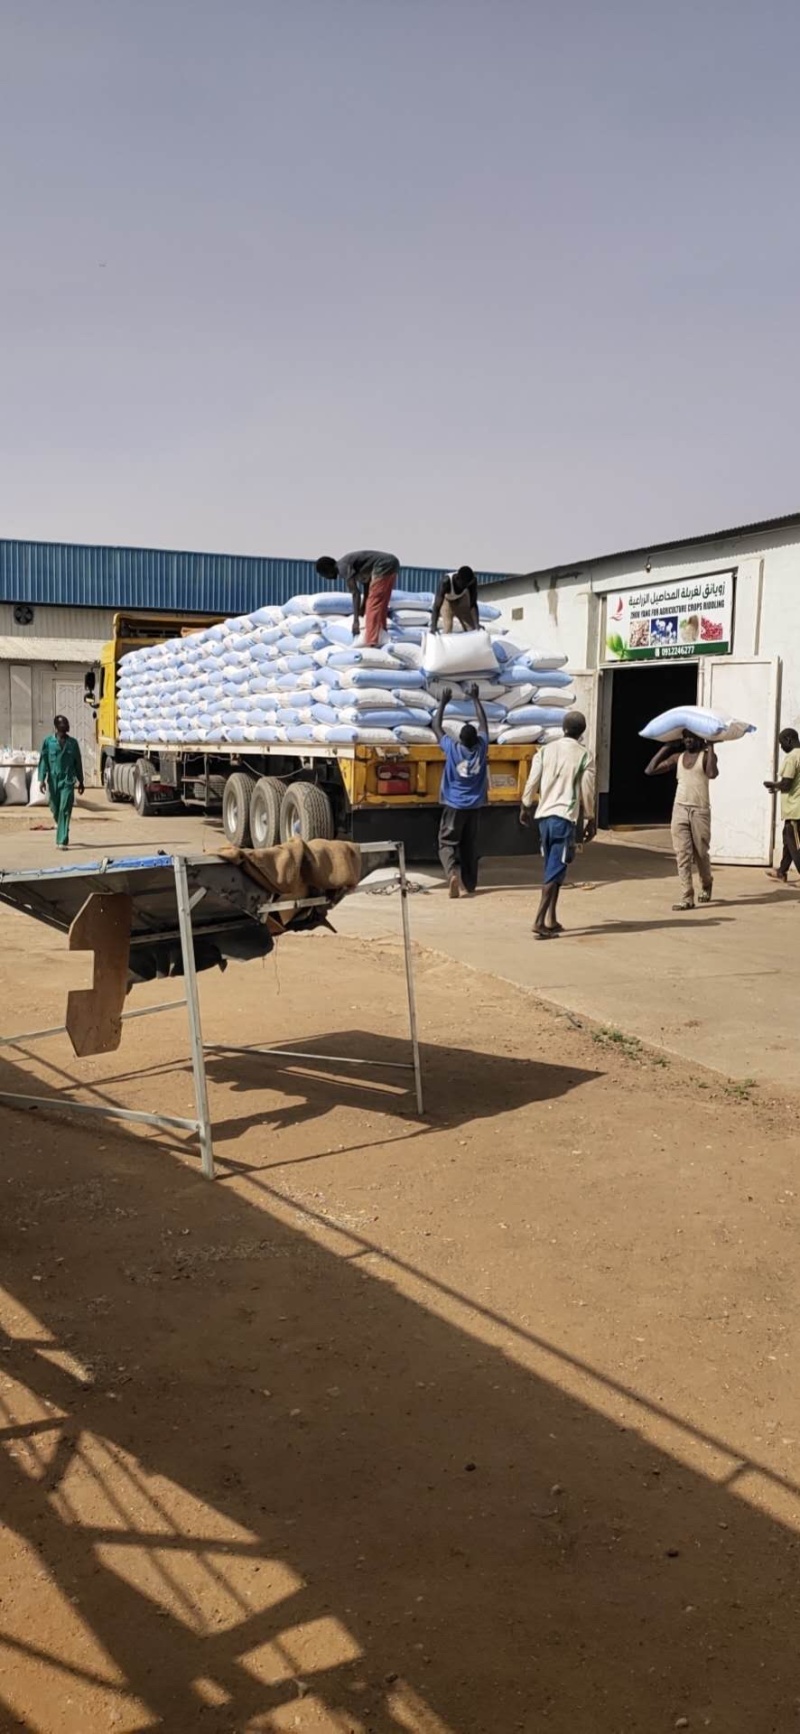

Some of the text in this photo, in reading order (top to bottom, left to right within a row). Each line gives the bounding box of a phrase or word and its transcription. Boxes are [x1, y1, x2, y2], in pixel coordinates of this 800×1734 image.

[629, 592, 650, 608] الزراعية
[650, 588, 680, 605] المحاصيل
[681, 585, 702, 601] لغربلة
[651, 607, 659, 617] FOR
[659, 604, 687, 616] AGRICULTURE
[688, 602, 702, 612] CROPS
[703, 599, 725, 610] RIDDLING
[661, 645, 695, 656] 0912246277
